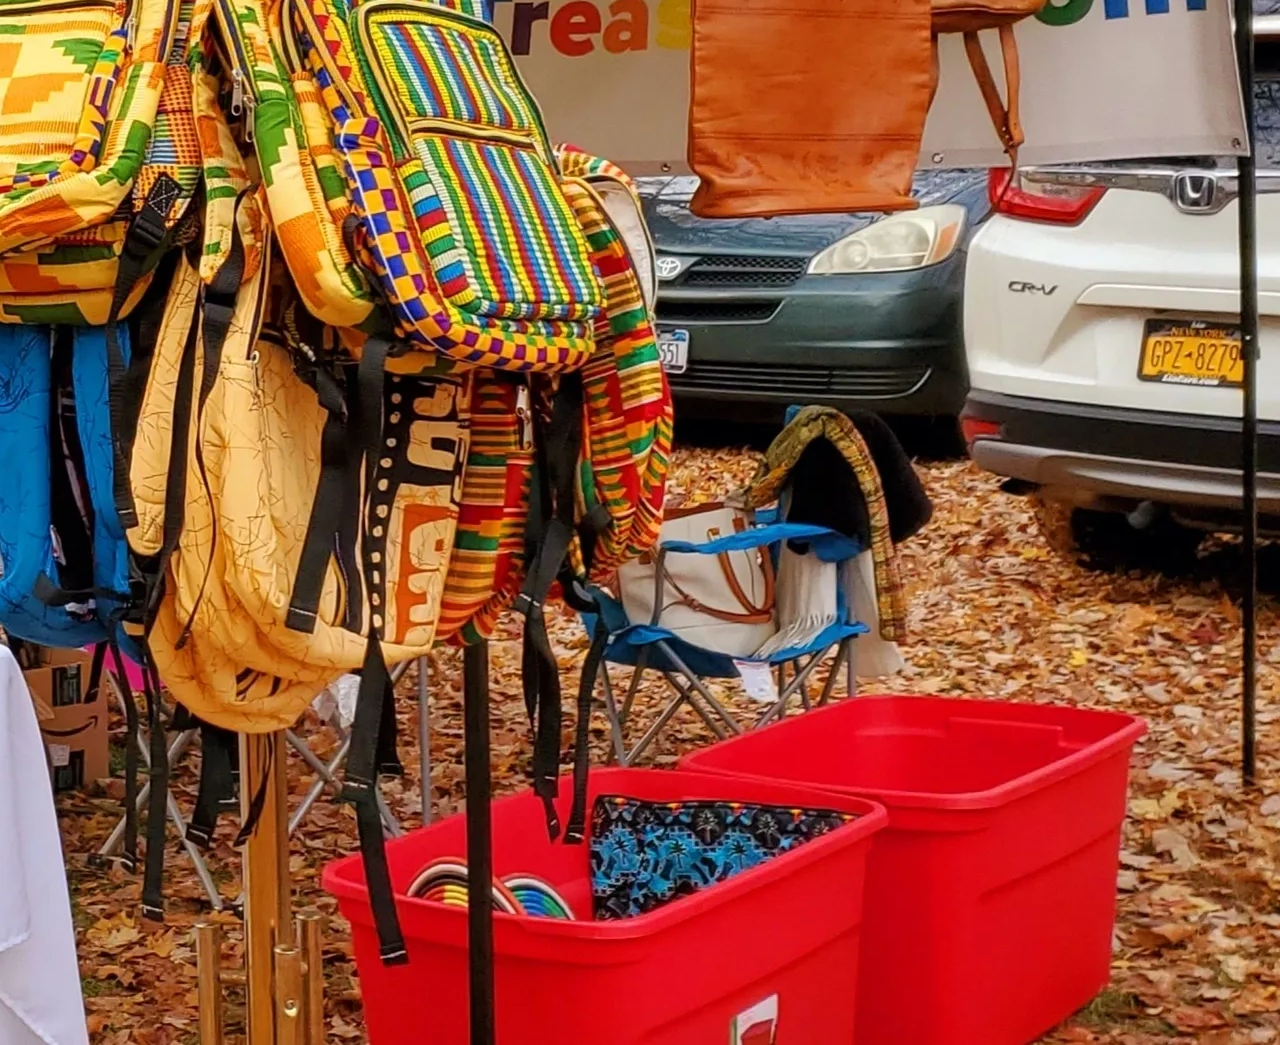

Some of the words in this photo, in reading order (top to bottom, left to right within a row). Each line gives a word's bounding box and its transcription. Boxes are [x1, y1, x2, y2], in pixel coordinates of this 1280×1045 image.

[1008, 280, 1059, 296] CR-V
[1150, 340, 1184, 369] GPZ
[1194, 342, 1239, 372] 8279
